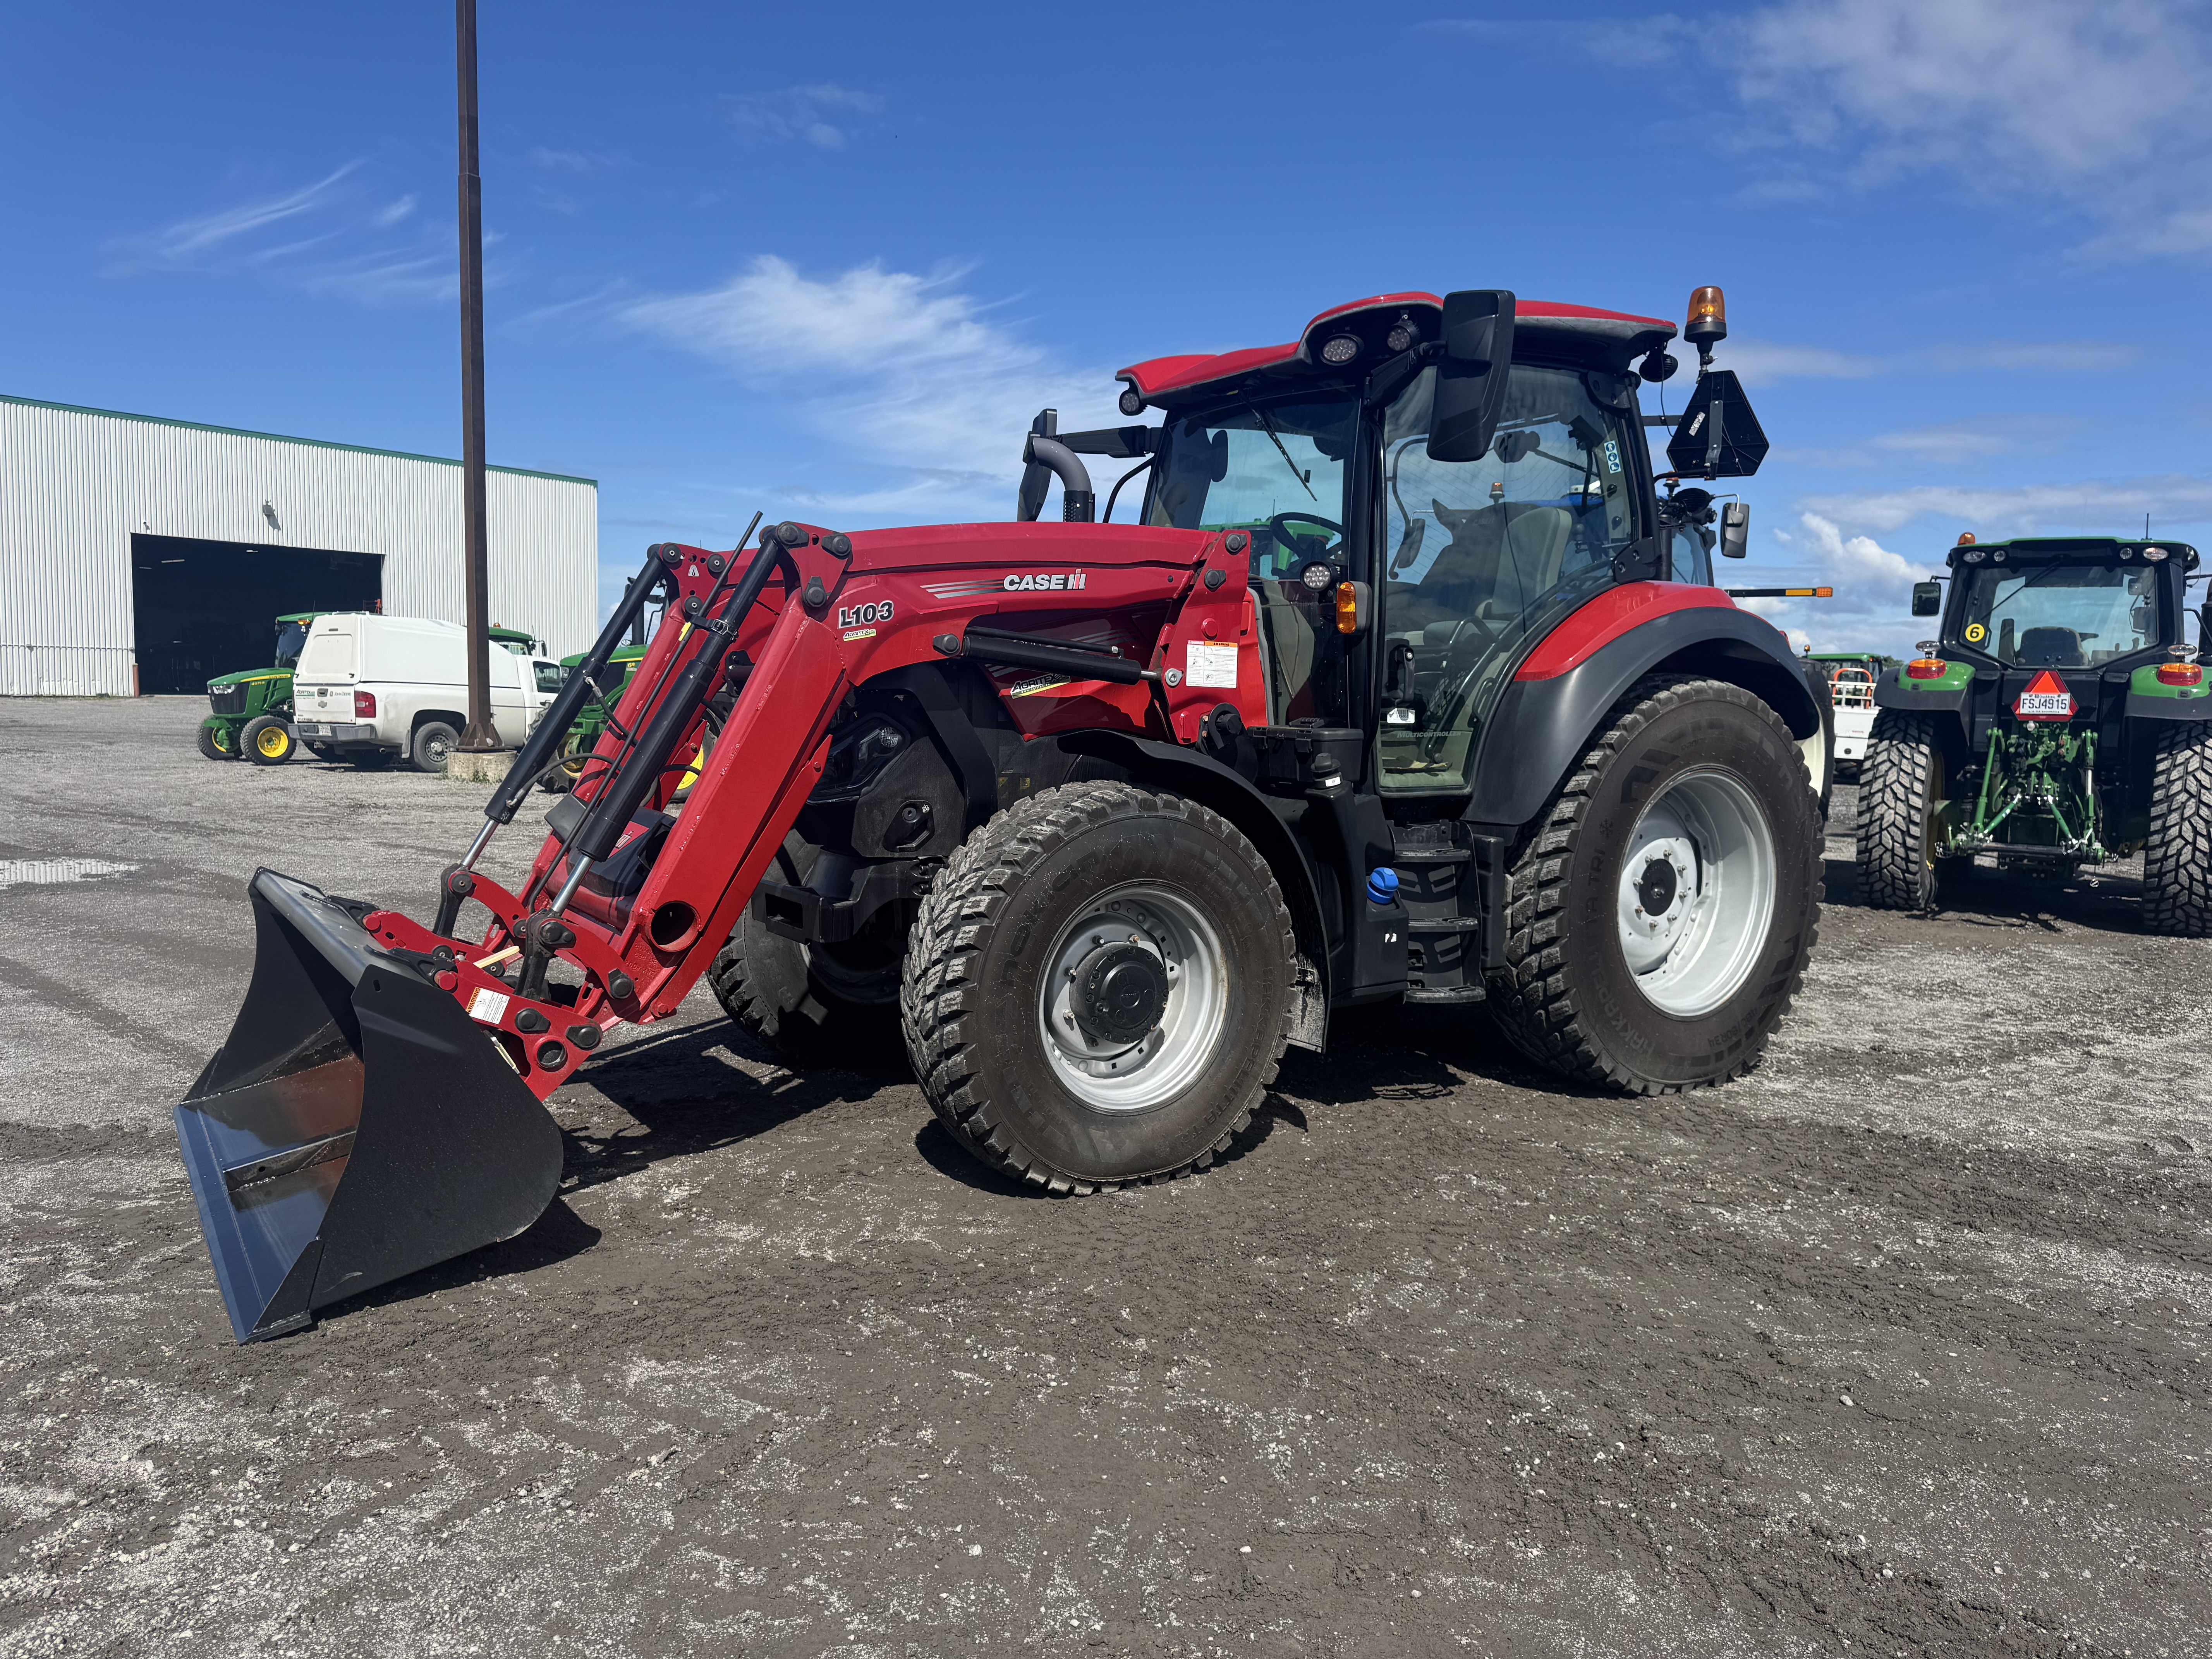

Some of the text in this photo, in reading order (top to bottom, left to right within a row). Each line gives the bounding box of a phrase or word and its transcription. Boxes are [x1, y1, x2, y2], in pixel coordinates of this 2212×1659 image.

[1003, 575, 1065, 591] CASE
[838, 600, 894, 629] L103
[1970, 627, 1980, 638] 6
[1012, 674, 1058, 692] AGRITEX
[2022, 698, 2067, 710] FSJ4915
[1587, 846, 1606, 887] TRI
[467, 987, 481, 1010] WARNING
